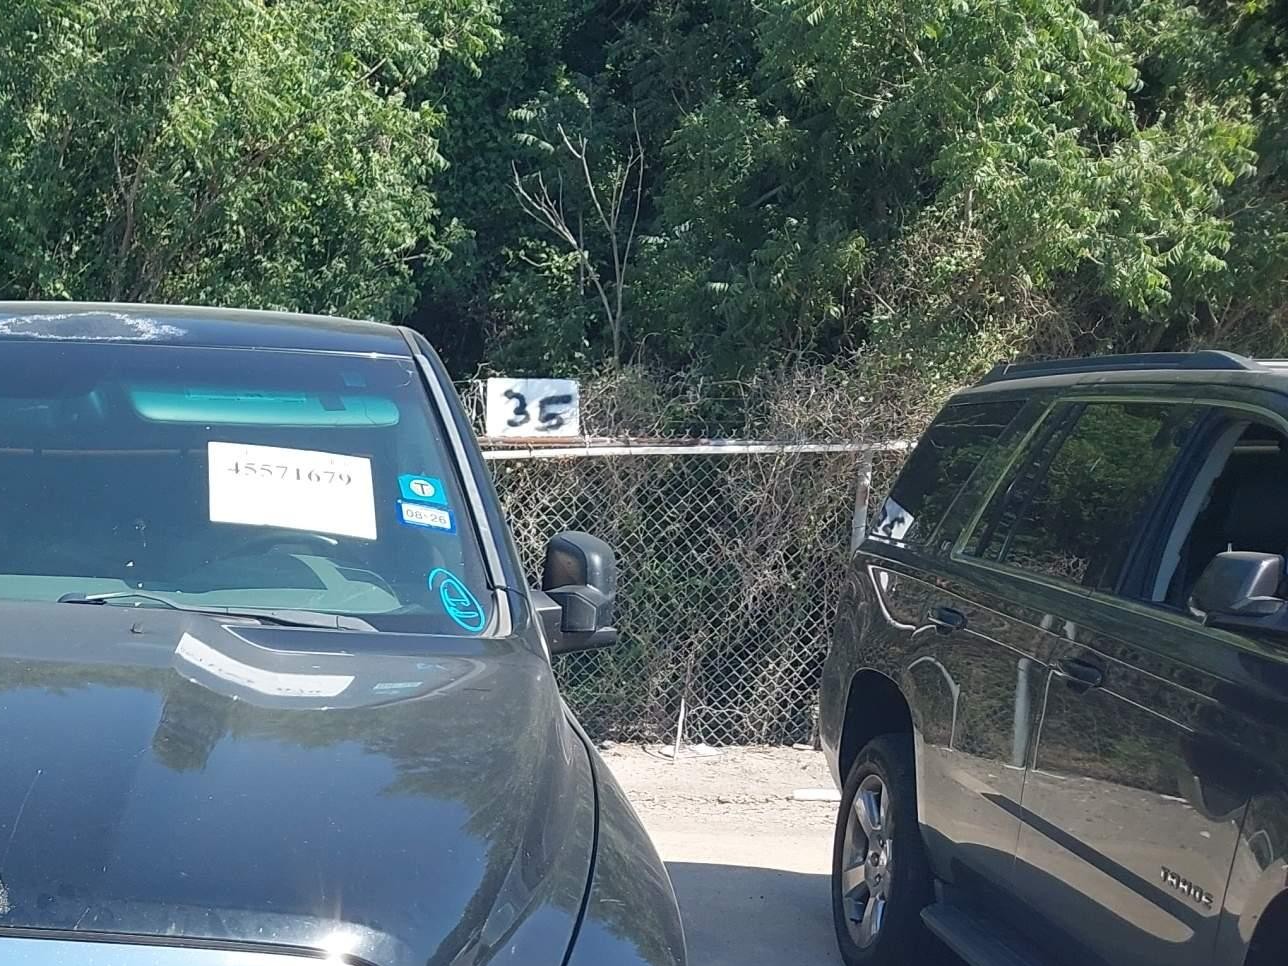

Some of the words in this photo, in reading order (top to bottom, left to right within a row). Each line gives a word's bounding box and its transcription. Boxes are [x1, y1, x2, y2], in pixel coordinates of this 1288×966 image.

[503, 389, 572, 431] 35
[227, 461, 352, 485] 45571679
[415, 481, 429, 495] T
[1160, 866, 1213, 910] TAHOE
